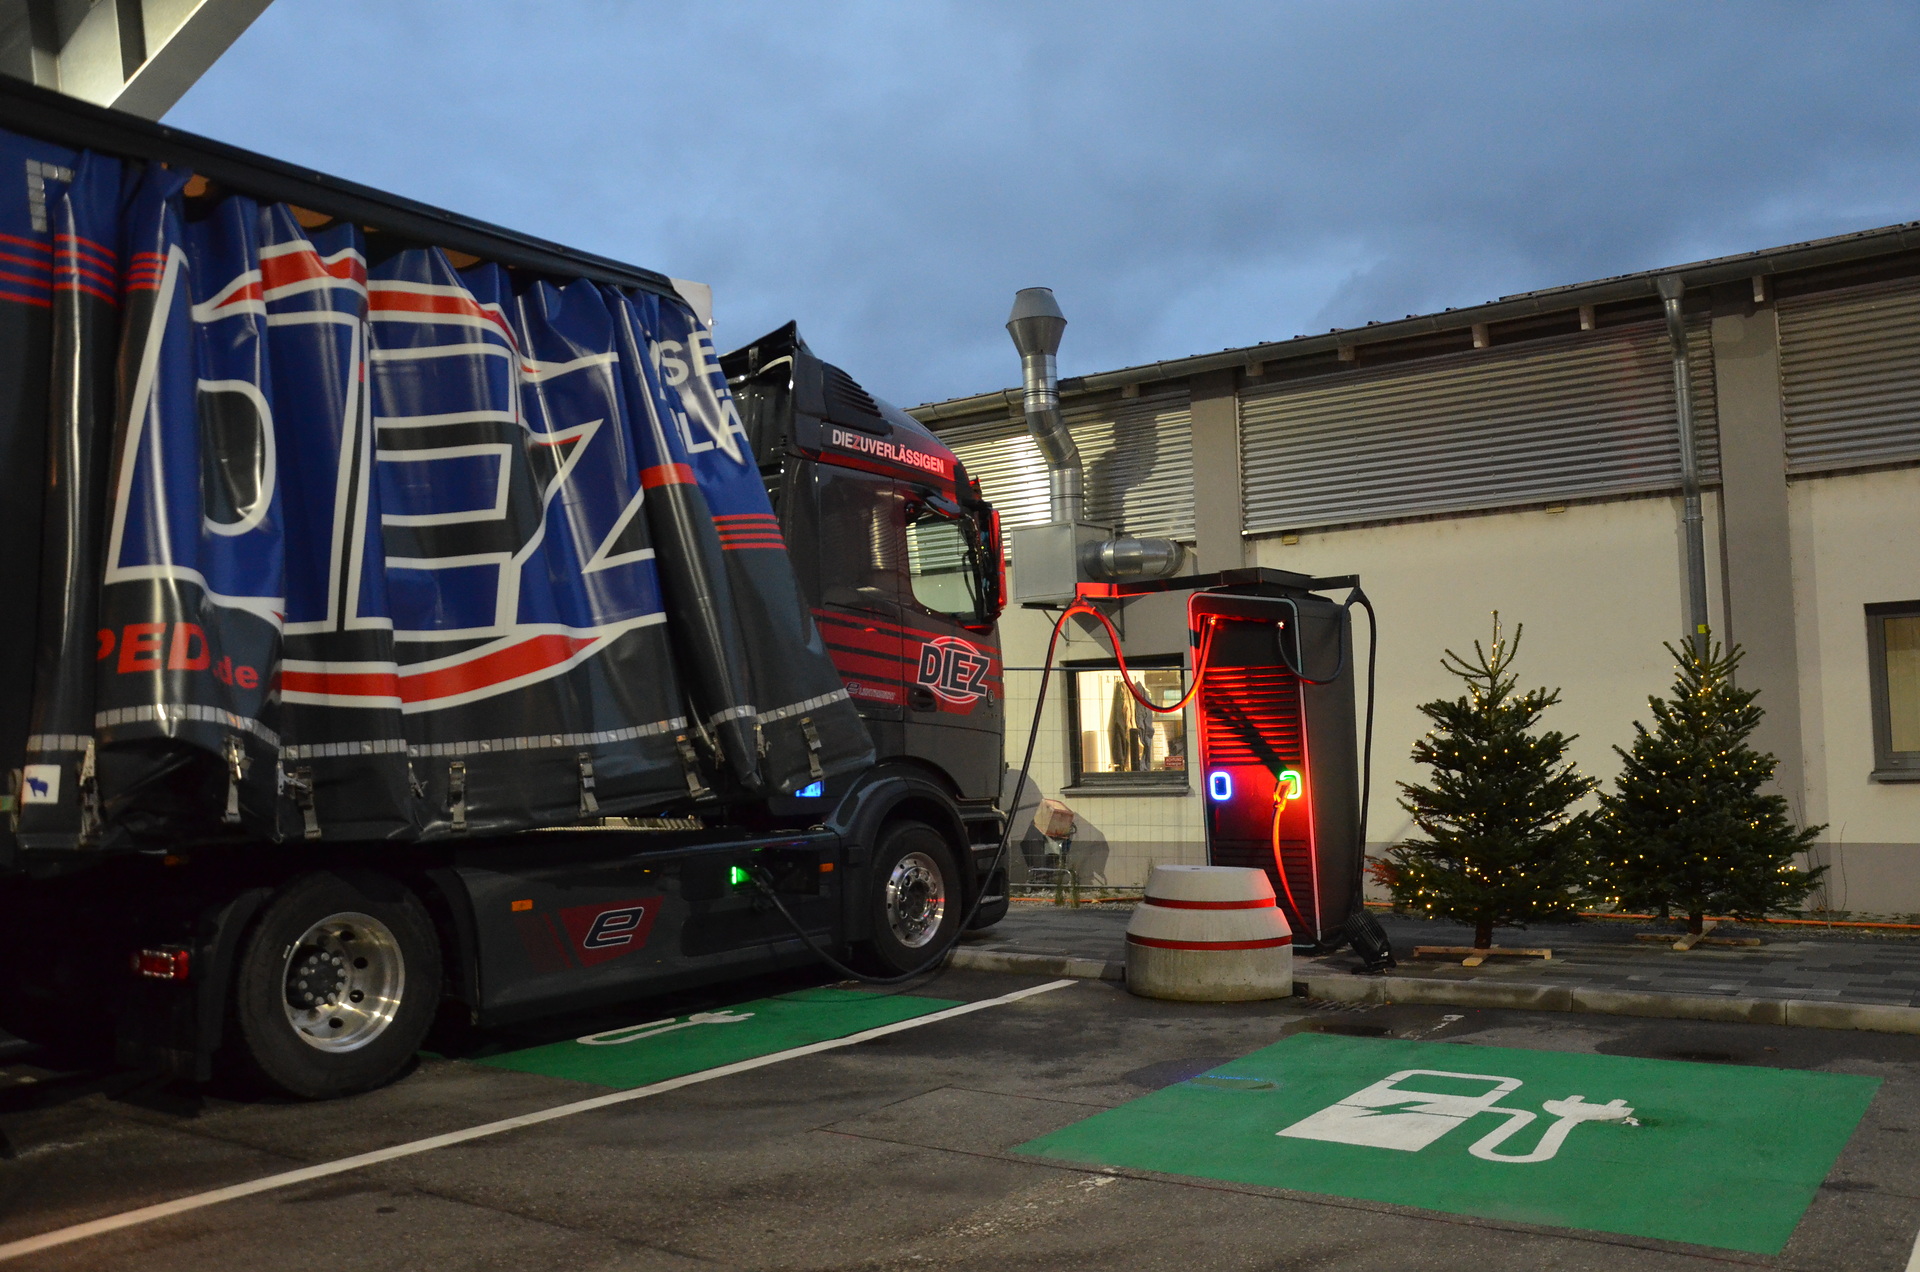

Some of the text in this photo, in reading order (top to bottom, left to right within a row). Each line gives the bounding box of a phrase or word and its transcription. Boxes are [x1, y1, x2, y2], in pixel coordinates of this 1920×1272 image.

[650, 329, 723, 399] SE
[104, 243, 667, 642] DIEZ
[668, 388, 749, 454] LÄ
[832, 428, 945, 474] DIEZUVERLÄSSIGEN
[916, 642, 991, 697] DIEZ
[583, 906, 645, 949] e
